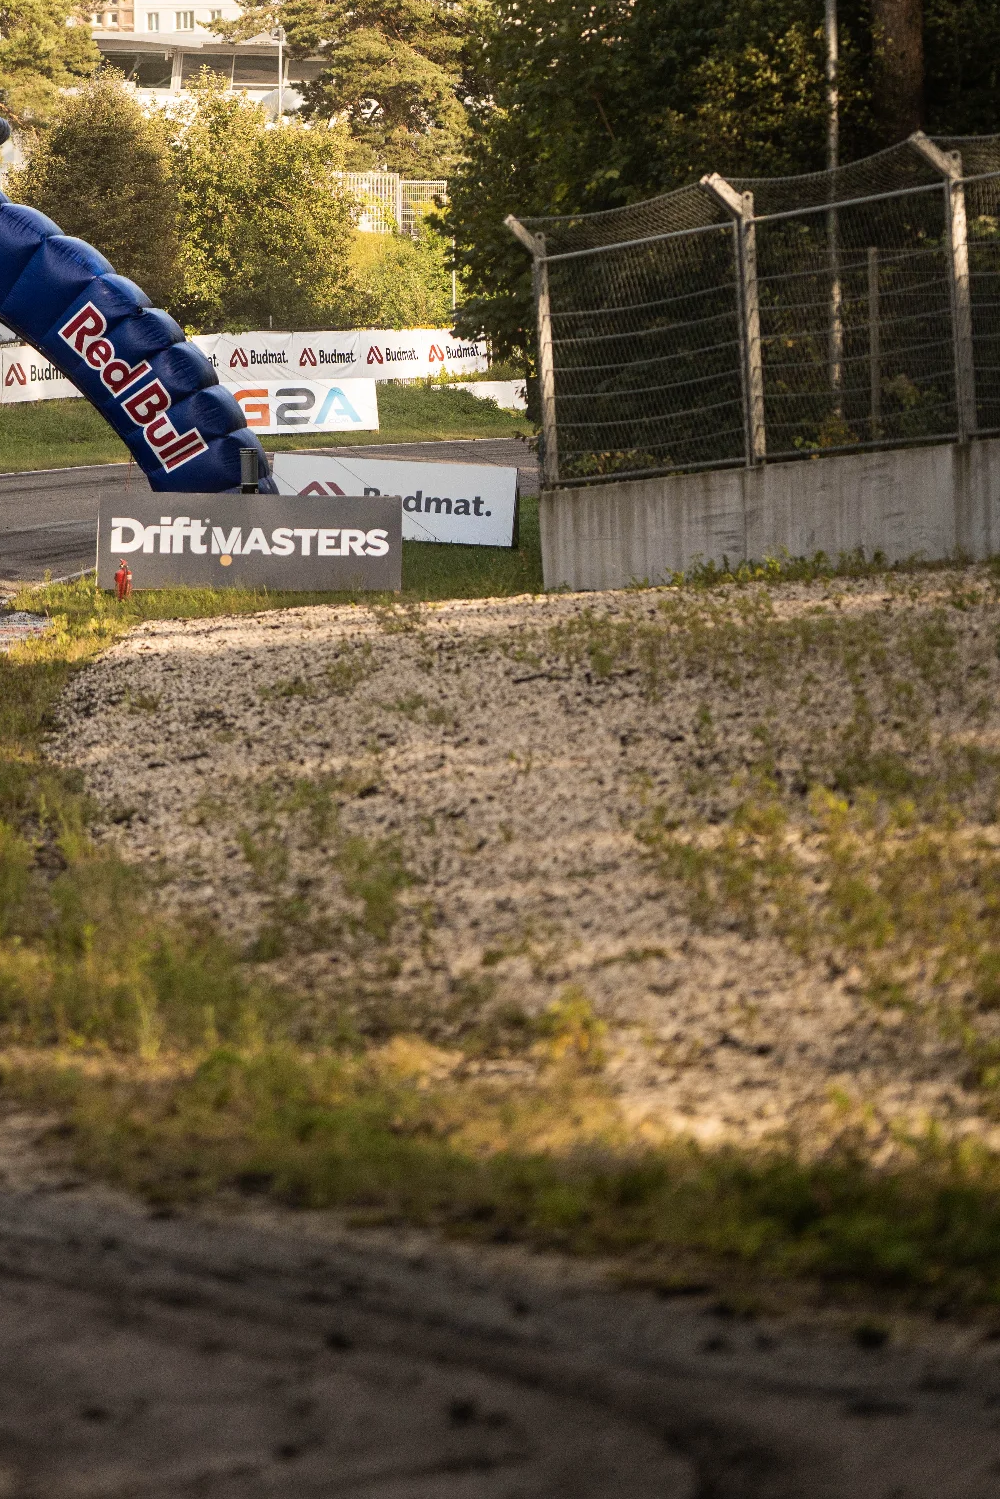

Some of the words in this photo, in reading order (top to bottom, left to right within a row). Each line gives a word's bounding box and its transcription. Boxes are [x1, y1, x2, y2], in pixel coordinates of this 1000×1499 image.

[250, 349, 289, 365] Budmat.
[319, 349, 357, 364] Budmat.
[385, 347, 419, 361] Budmat.
[446, 342, 482, 359] Budmat.
[30, 363, 68, 382] Budm
[58, 301, 152, 398] Red
[121, 378, 209, 474] Bull
[363, 486, 492, 517] dmat.
[110, 515, 208, 554] Drift
[210, 526, 390, 556] MASTERS
